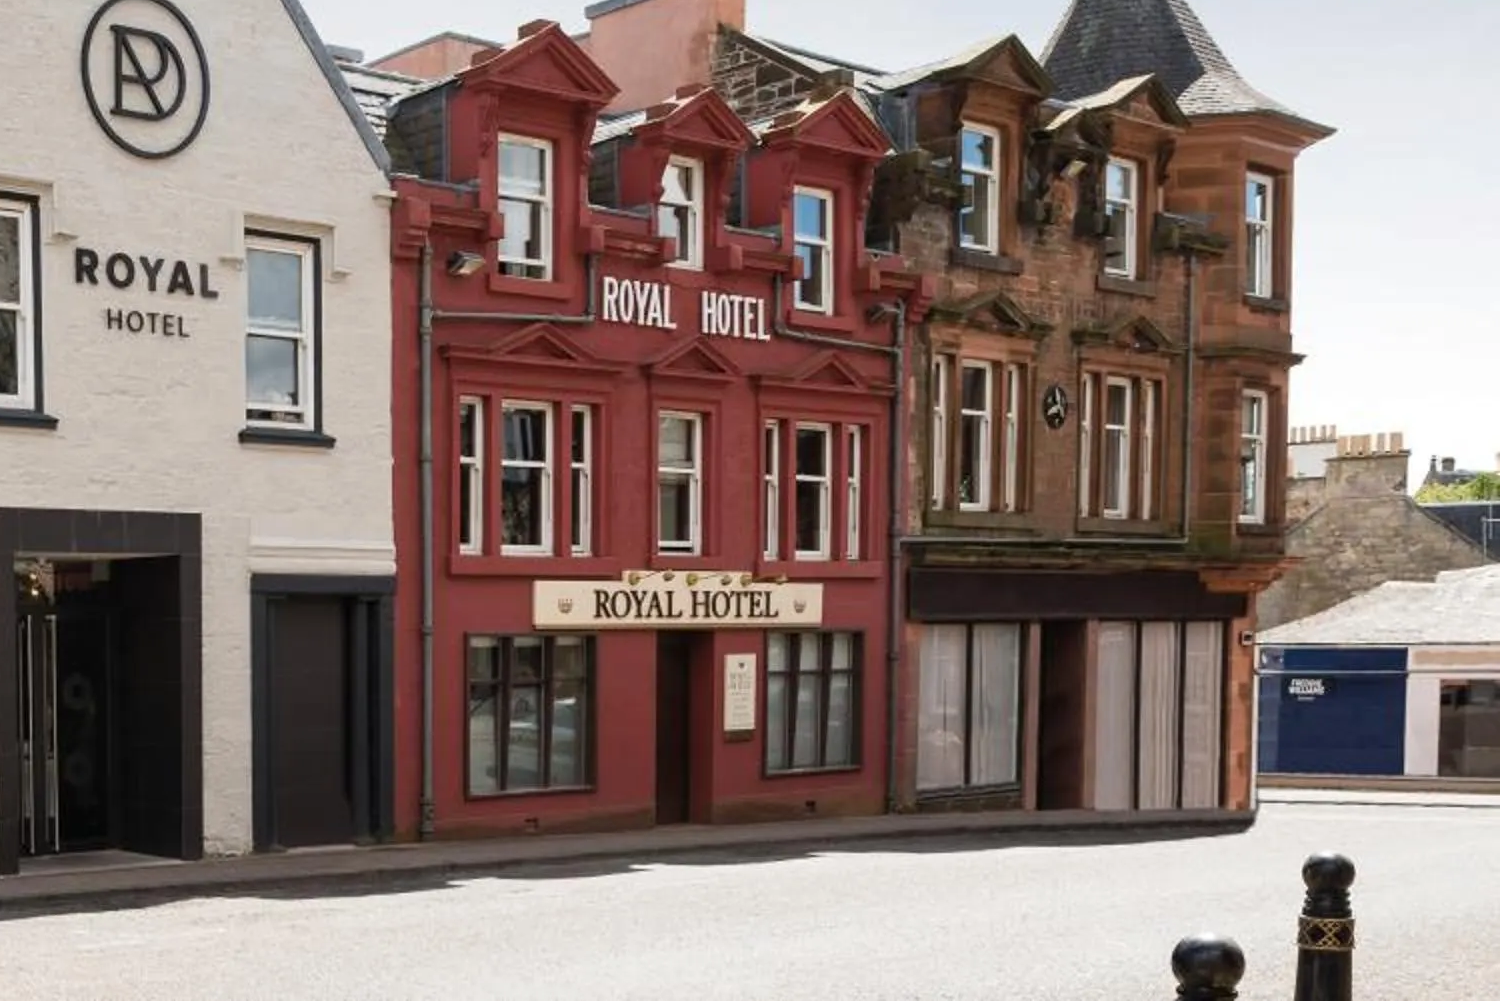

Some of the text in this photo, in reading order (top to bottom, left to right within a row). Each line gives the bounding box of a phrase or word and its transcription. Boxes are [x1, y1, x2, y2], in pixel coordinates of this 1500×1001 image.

[74, 247, 219, 299] ROYAL
[107, 308, 190, 338] HOTEL
[603, 276, 771, 341] ROYAL HOTEL
[593, 590, 779, 619] ROYAL HOTEL
